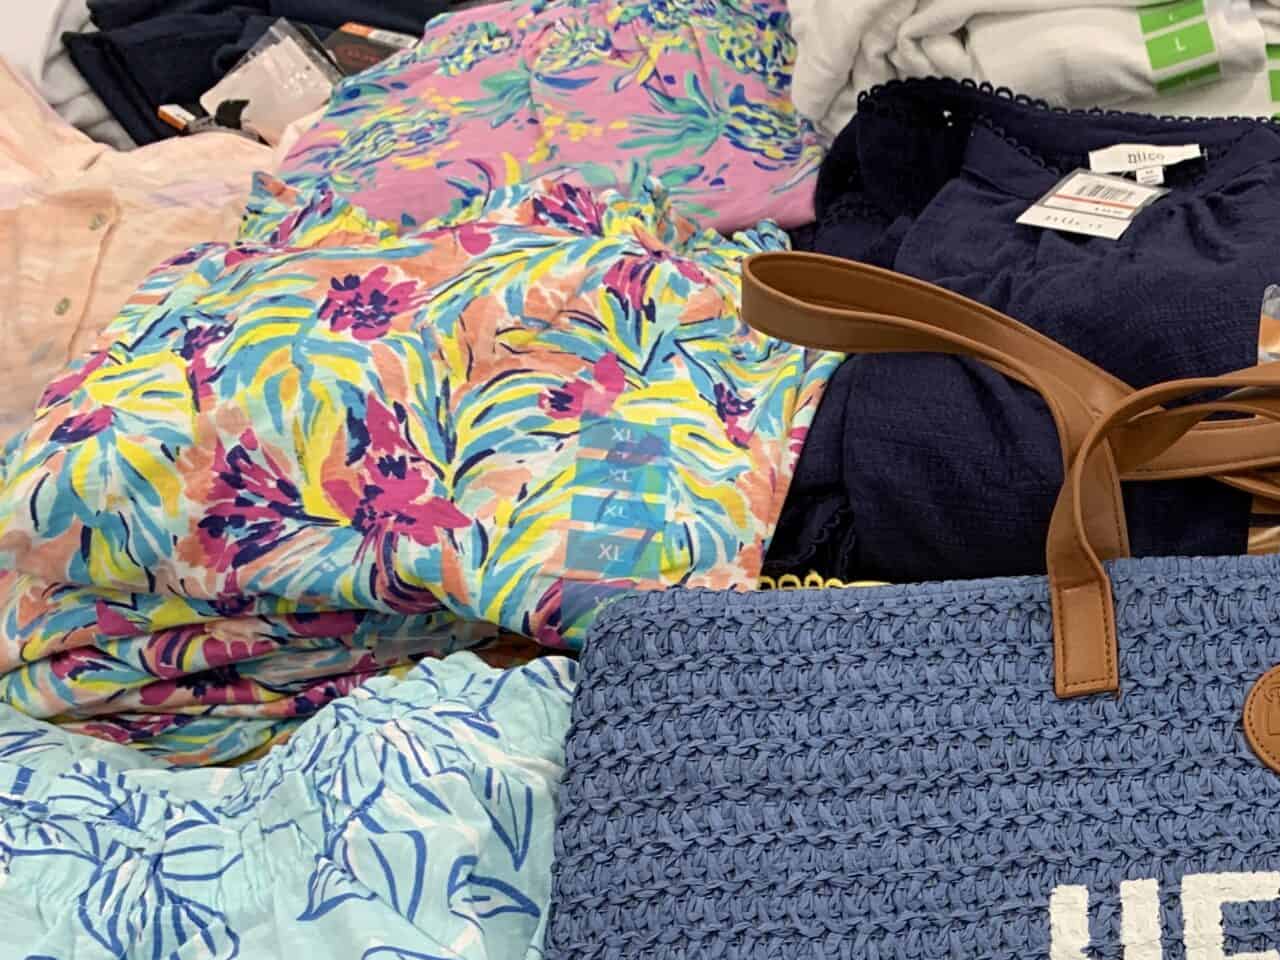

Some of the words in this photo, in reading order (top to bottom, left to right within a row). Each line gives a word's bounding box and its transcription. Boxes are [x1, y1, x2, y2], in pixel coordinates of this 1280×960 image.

[1174, 36, 1187, 51] L
[611, 427, 639, 443] XL
[608, 468, 633, 483] XL
[603, 504, 626, 518] XL
[598, 543, 624, 562] XL
